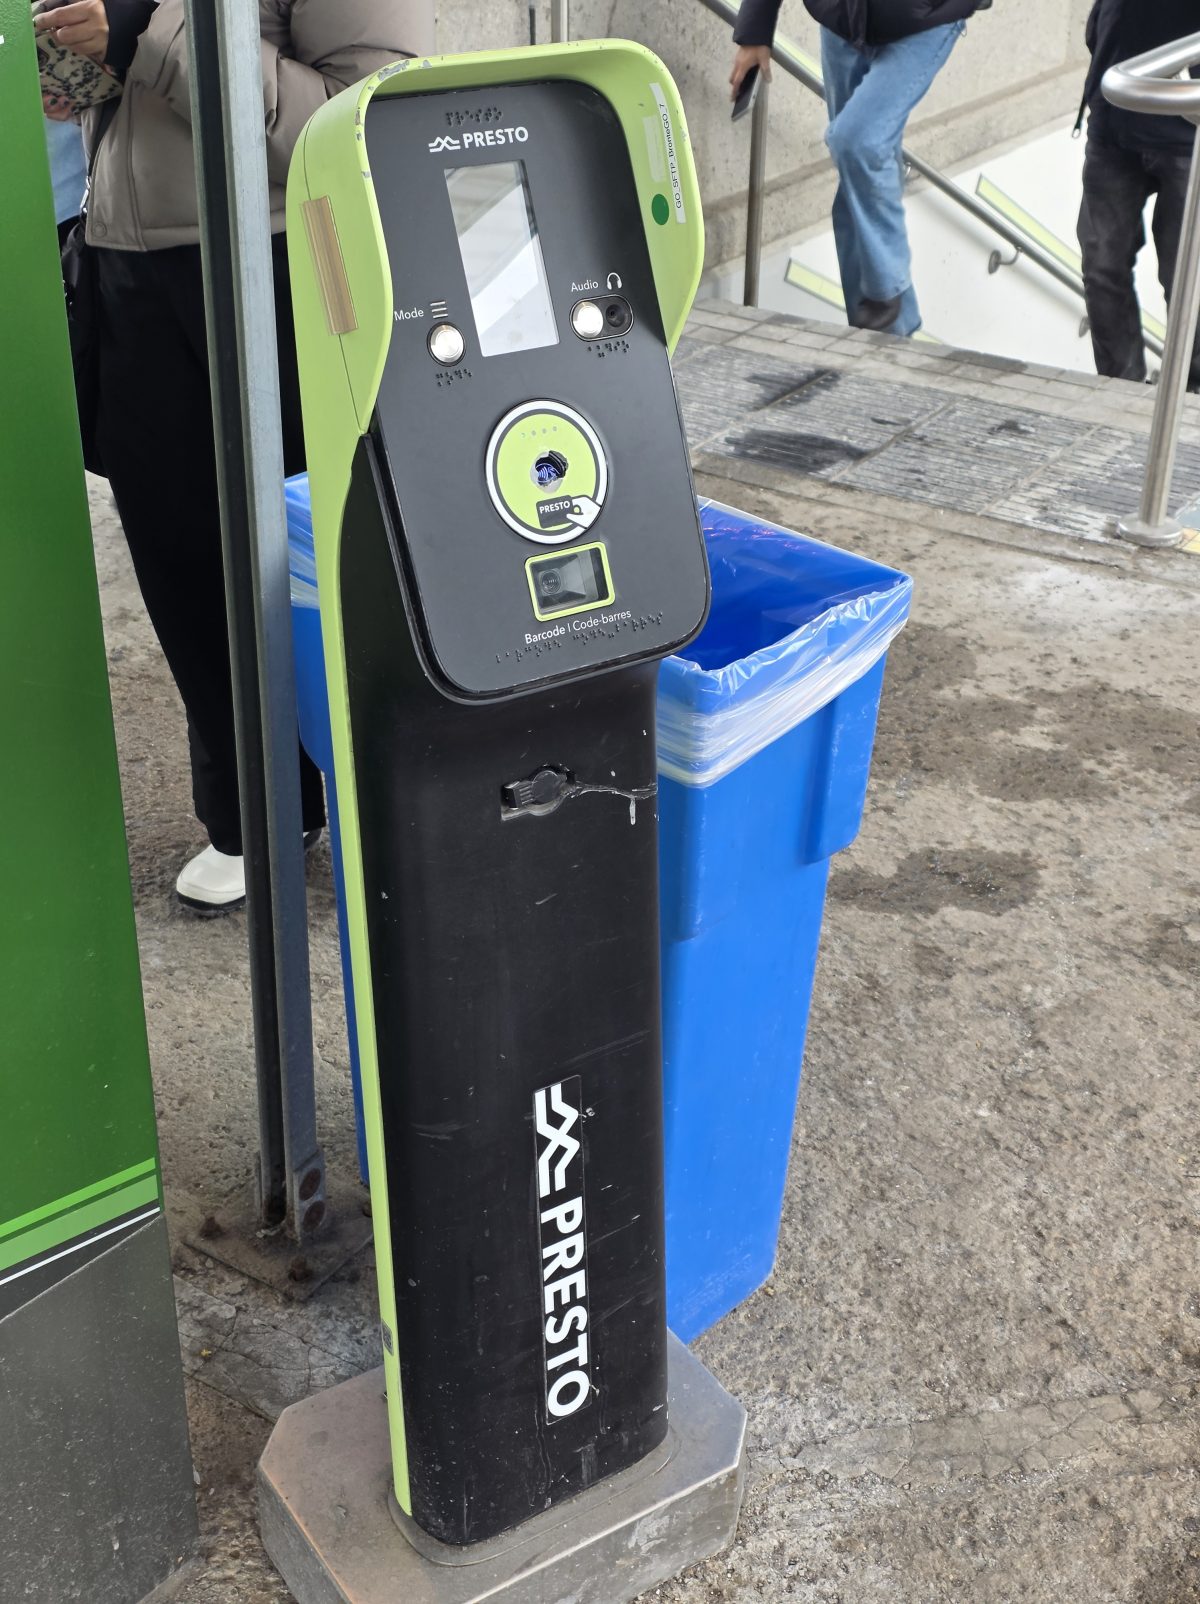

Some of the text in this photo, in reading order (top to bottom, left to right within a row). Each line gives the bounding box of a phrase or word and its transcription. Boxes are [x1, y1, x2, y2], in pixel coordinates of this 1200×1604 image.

[463, 126, 529, 150] PRESTO
[571, 279, 599, 292] Audio
[394, 307, 424, 321] Mode
[539, 500, 571, 514] PRESTO
[525, 624, 566, 644] Barcode
[573, 609, 632, 631] Code-barres
[540, 1195, 590, 1417] PRESTO
